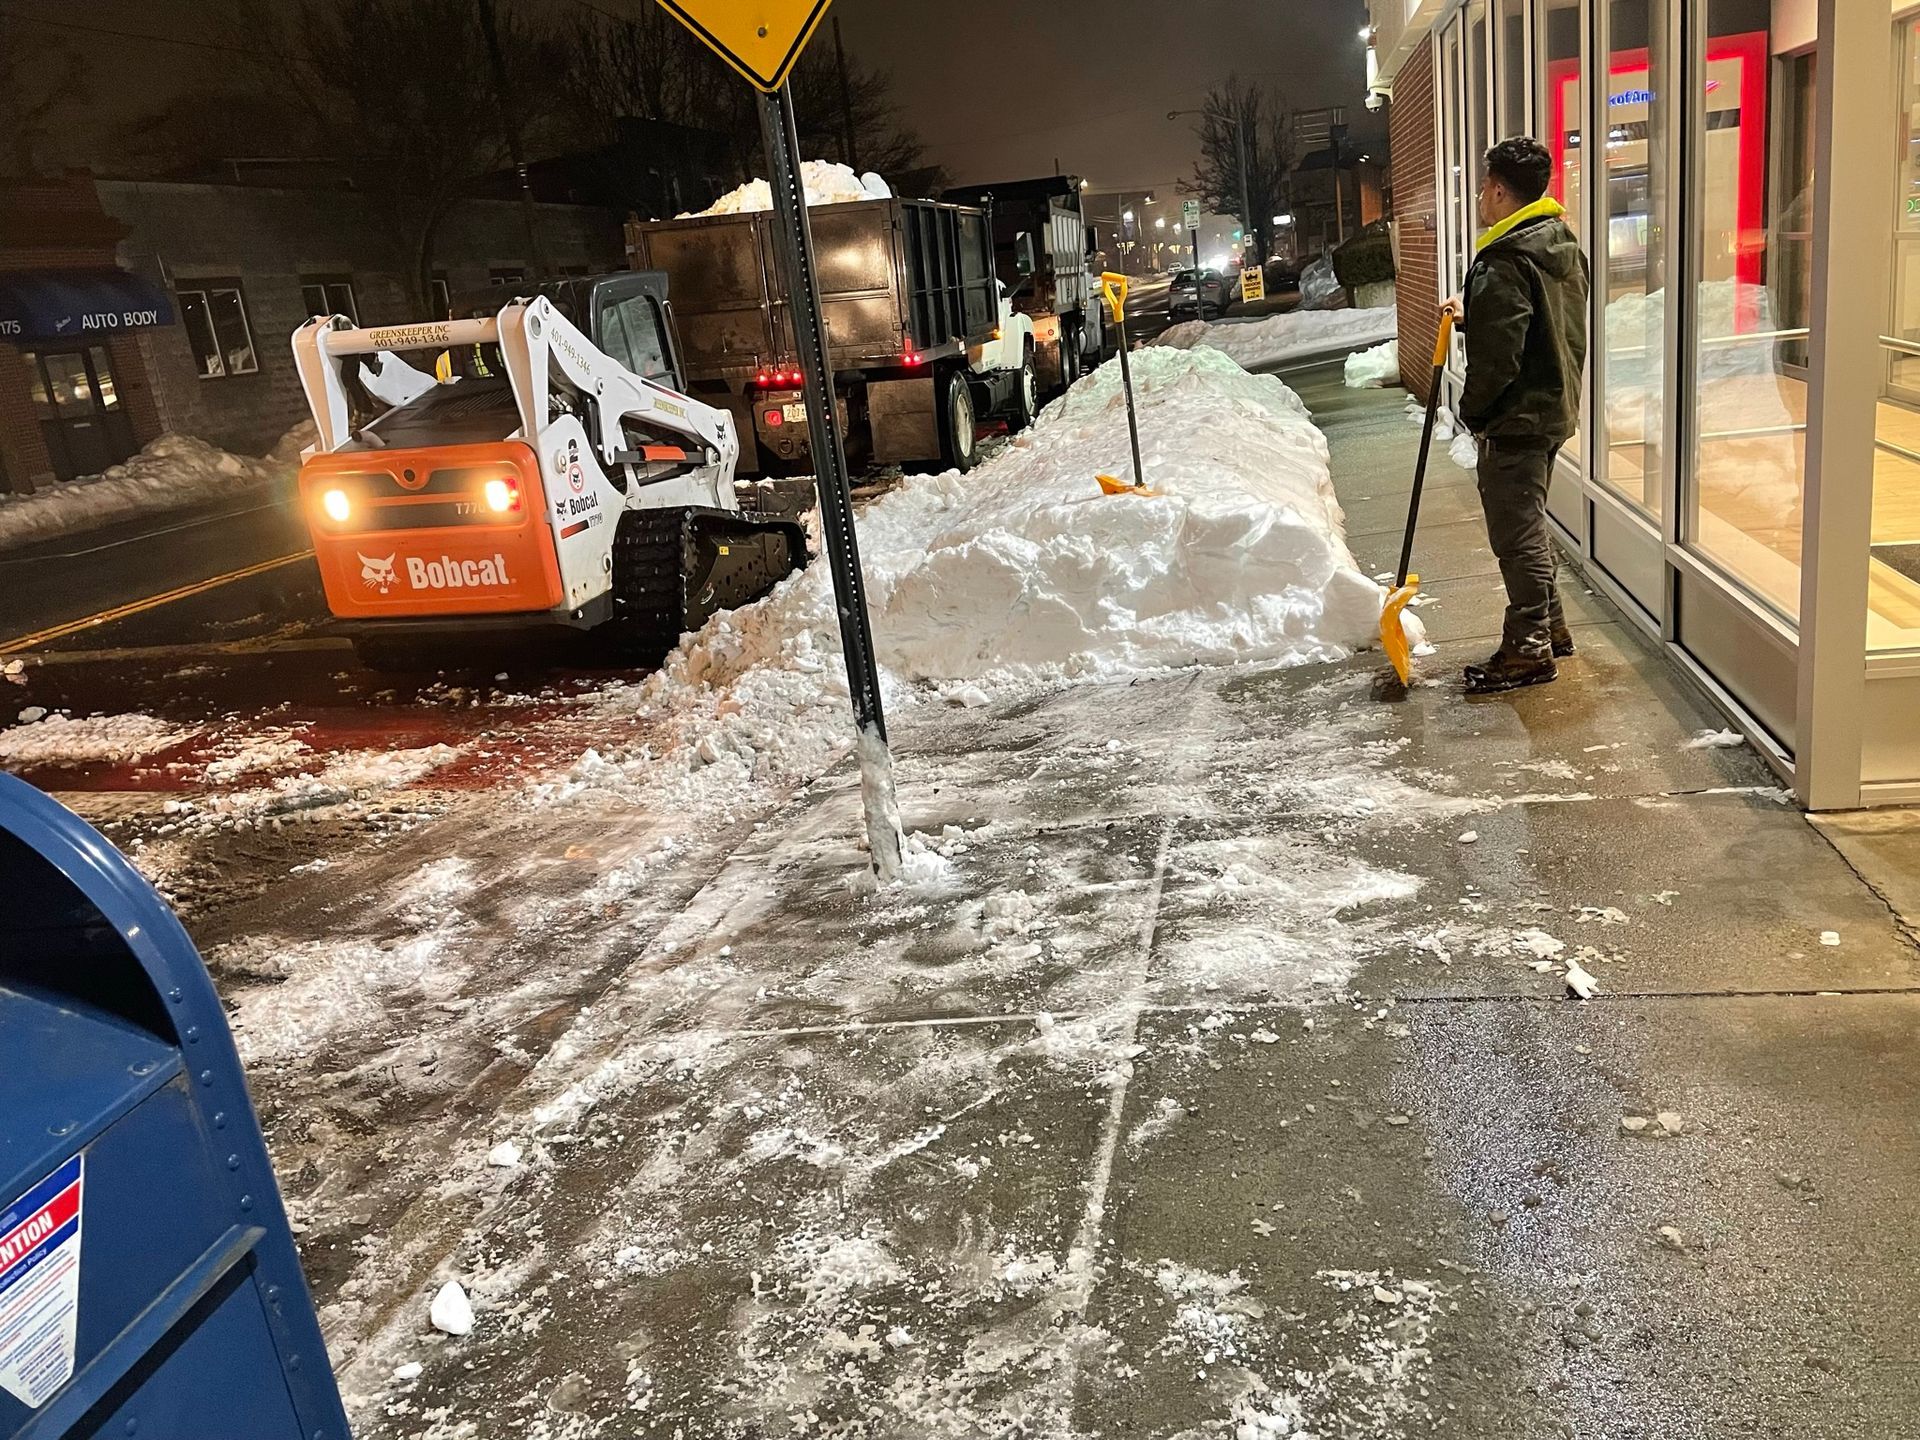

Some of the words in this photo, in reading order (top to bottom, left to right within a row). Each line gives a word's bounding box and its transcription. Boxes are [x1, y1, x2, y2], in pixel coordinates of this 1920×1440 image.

[0, 320, 21, 335] 175
[82, 313, 118, 329] AUTO
[123, 310, 157, 326] BODY
[369, 326, 432, 340] GREENSKEEPER
[374, 334, 449, 348] 401-949-1346
[551, 328, 591, 376] 401-949-1346
[569, 490, 599, 515] Bobcat
[405, 553, 510, 590] Bobcat
[0, 1210, 54, 1271] NTION
